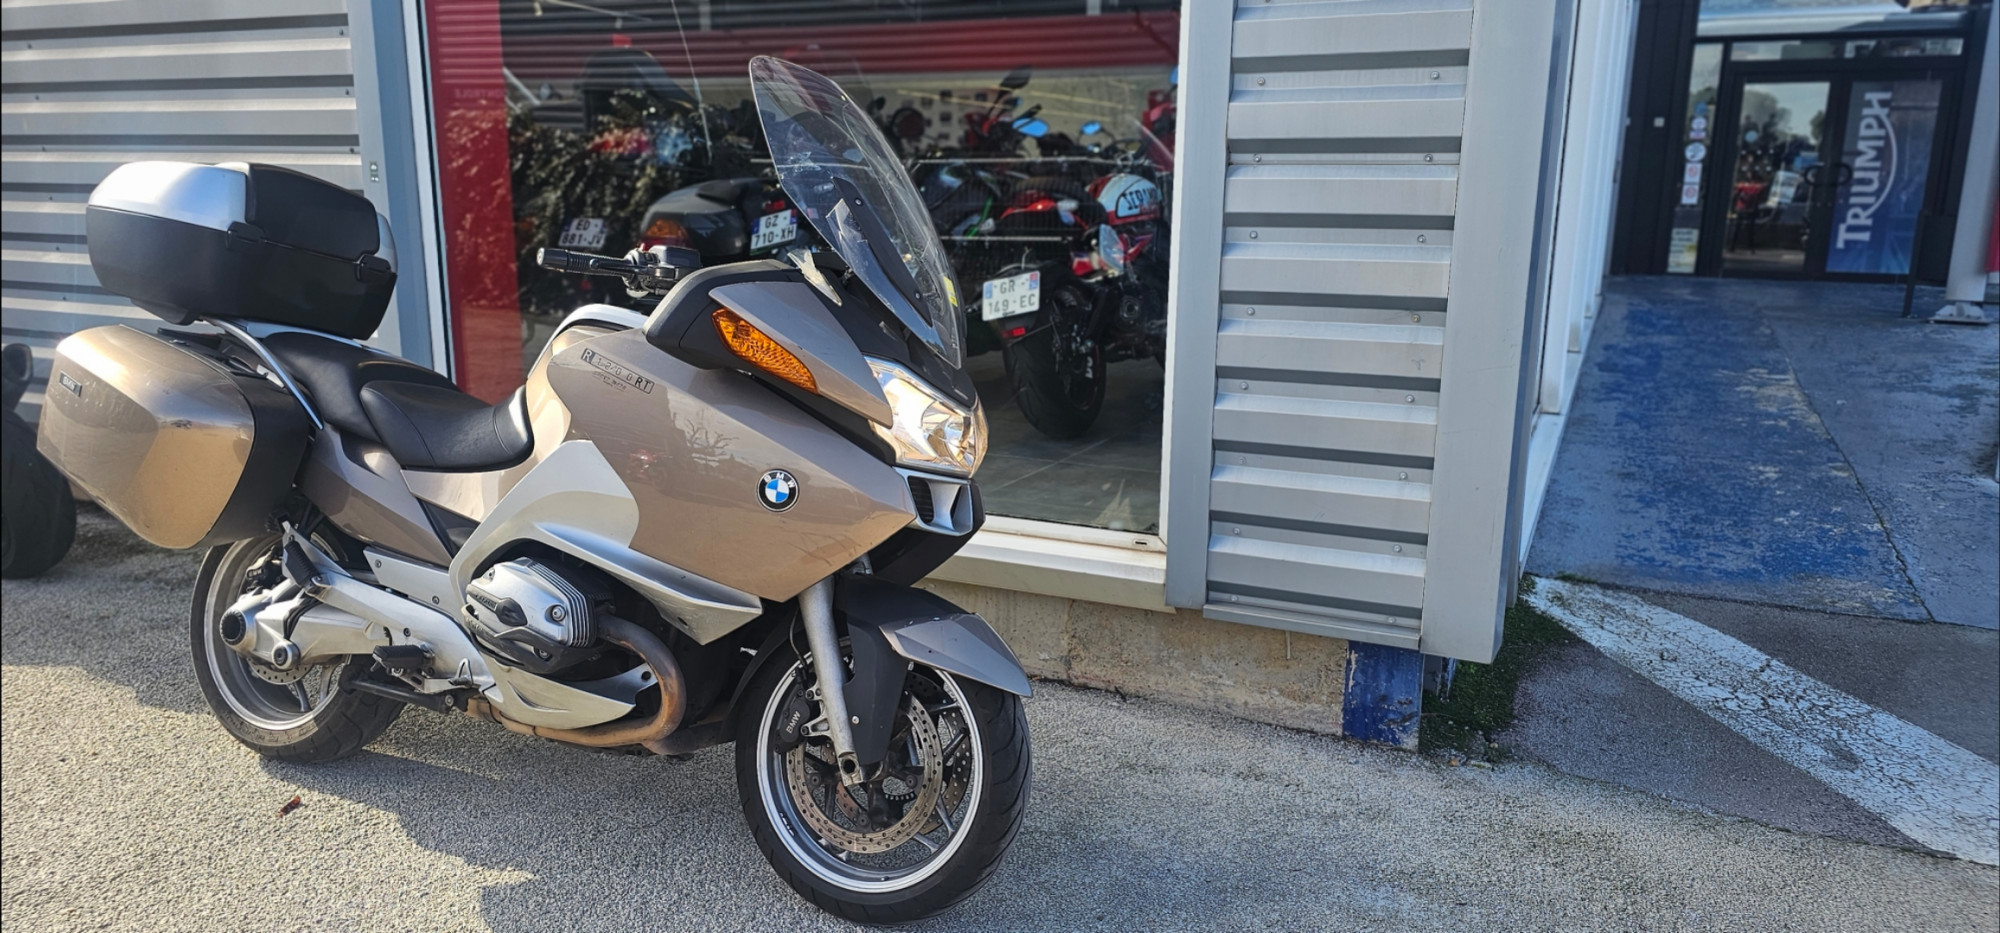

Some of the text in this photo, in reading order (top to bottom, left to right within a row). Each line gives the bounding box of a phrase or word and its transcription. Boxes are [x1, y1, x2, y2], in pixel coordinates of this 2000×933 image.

[1836, 92, 1895, 249] TRIUMPH
[763, 472, 796, 488] BMW
[786, 711, 801, 734] BMW
